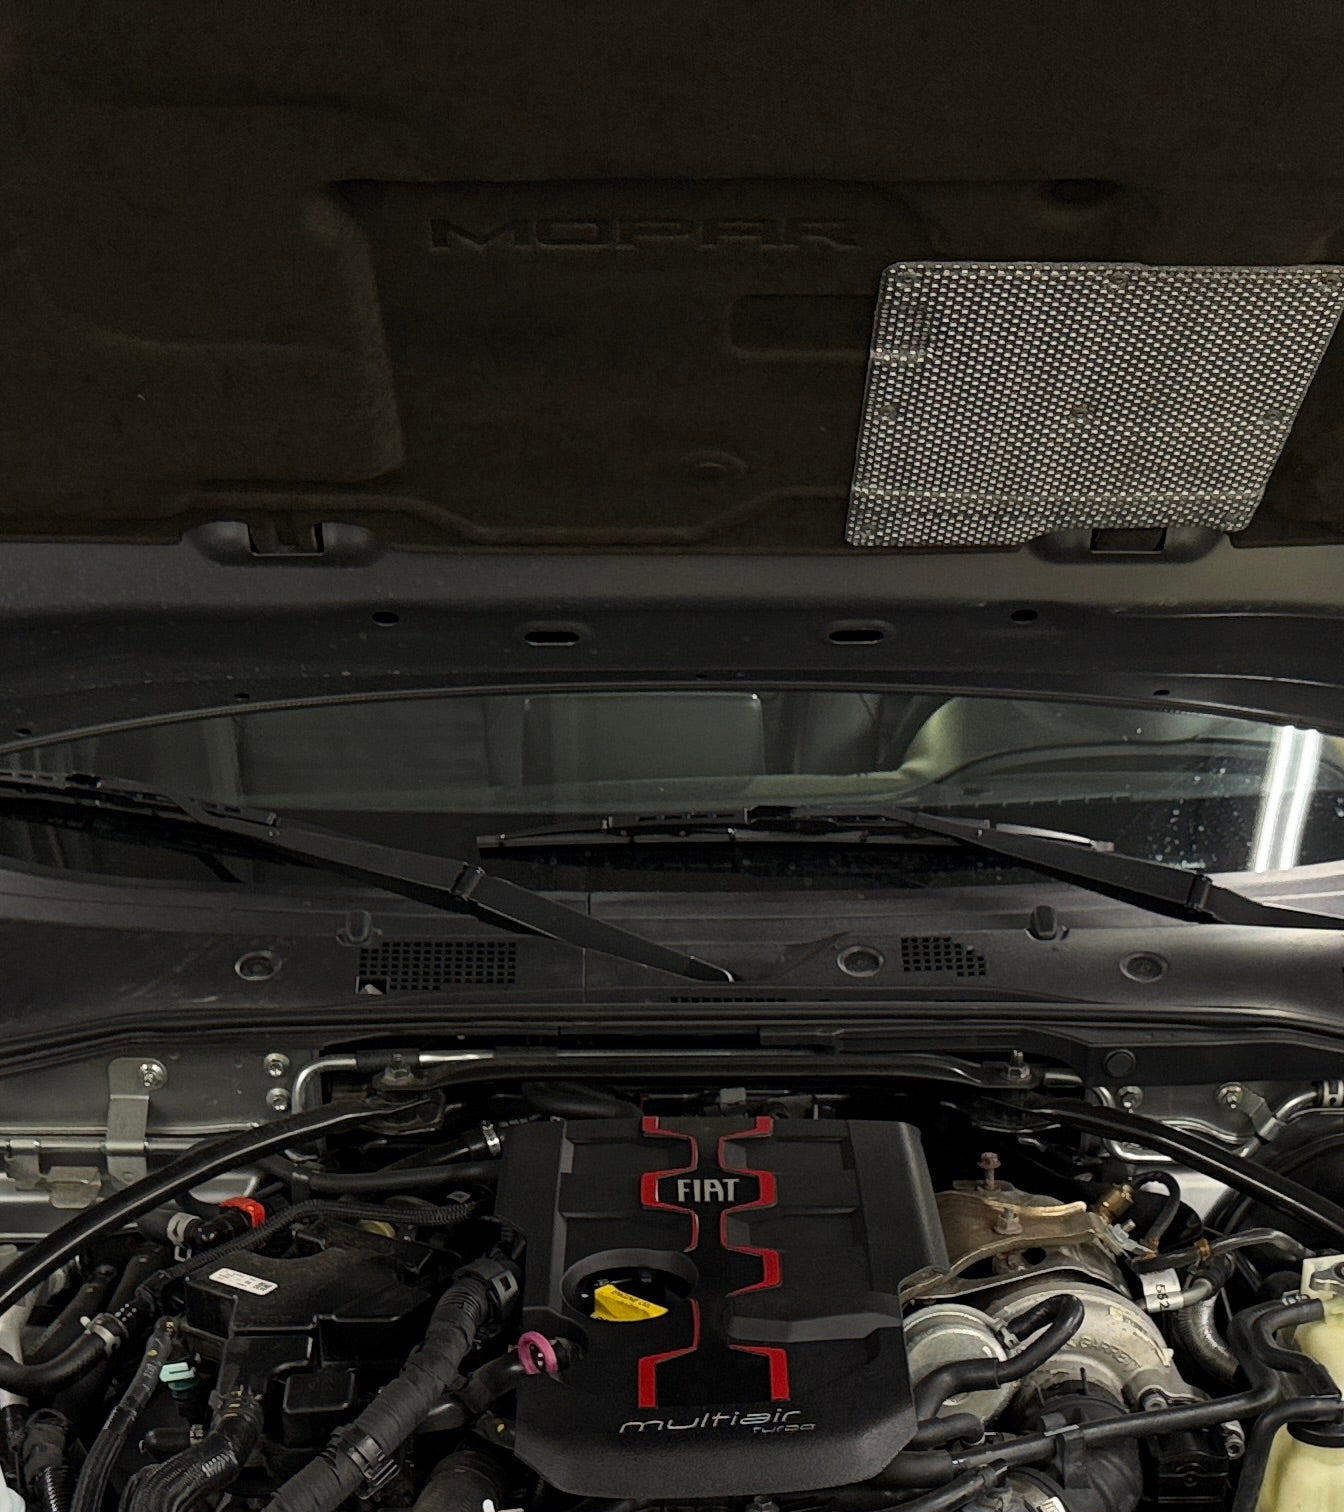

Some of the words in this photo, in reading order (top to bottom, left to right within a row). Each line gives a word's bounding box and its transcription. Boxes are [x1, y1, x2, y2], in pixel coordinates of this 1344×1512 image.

[429, 217, 863, 252] MOPAR
[677, 1178, 741, 1203] FIAT
[619, 1408, 801, 1433] multiair
